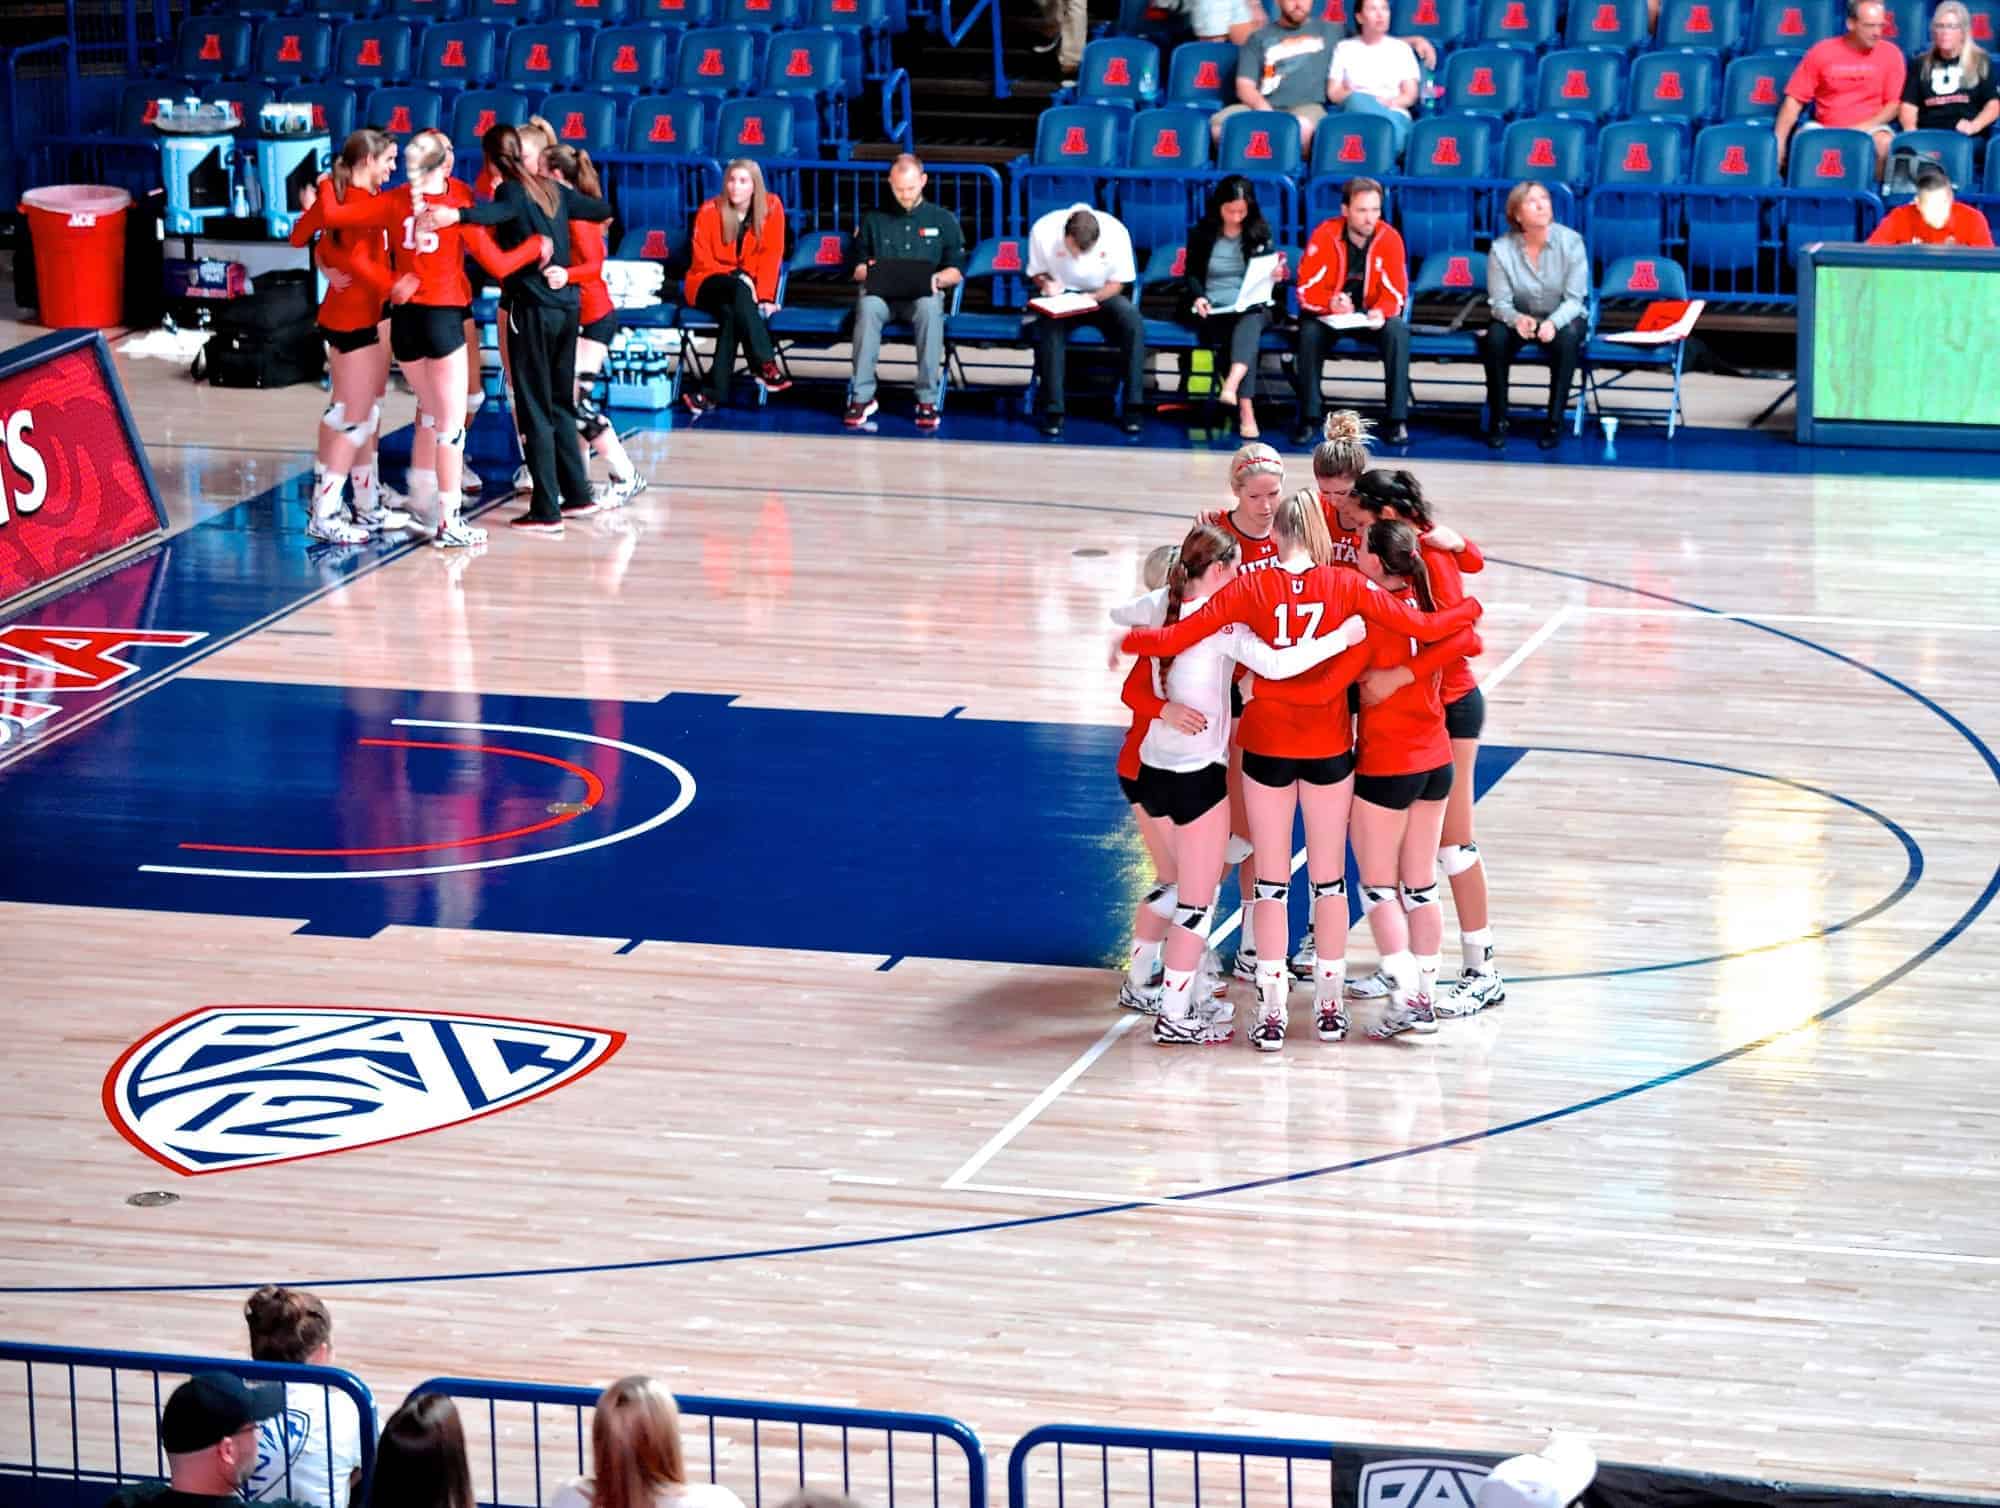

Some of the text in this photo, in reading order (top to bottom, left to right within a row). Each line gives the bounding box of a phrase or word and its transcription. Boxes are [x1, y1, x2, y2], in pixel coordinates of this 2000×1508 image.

[1320, 0, 1347, 23] A
[1412, 0, 1439, 24] A
[1501, 3, 1529, 29] A
[1592, 5, 1620, 31] A
[1685, 6, 1714, 32] A
[1778, 9, 1805, 35] A
[199, 35, 222, 60] A
[277, 36, 302, 61] A
[356, 39, 383, 66] A
[441, 40, 466, 67] A
[525, 44, 552, 71] A
[612, 45, 639, 73] A
[698, 49, 725, 75] A
[786, 50, 813, 76] A
[1103, 58, 1130, 85] A
[1194, 62, 1221, 89] A
[1468, 69, 1496, 95] A
[1561, 71, 1590, 98] A
[1655, 72, 1683, 99] A
[1750, 77, 1778, 104] A
[386, 106, 413, 133] A
[560, 112, 587, 139] A
[648, 115, 677, 142] A
[738, 117, 766, 145] A
[1061, 127, 1089, 154] A
[1153, 130, 1181, 157] A
[1245, 132, 1272, 159] A
[1338, 135, 1366, 161] A
[1432, 137, 1461, 165] A
[1527, 139, 1556, 166] A
[1623, 144, 1651, 171] A
[1720, 147, 1748, 174] A
[1816, 150, 1845, 177] A
[640, 231, 669, 259] A
[814, 236, 843, 265] A
[993, 242, 1022, 270] A
[1443, 258, 1473, 287] A
[1627, 262, 1659, 291] A
[1239, 555, 1280, 574] UTA
[1291, 579, 1304, 594] U
[1273, 602, 1325, 647] 17
[137, 1012, 590, 1110] PAC
[174, 1091, 385, 1141] 12
[1367, 1467, 1487, 1508] PA
